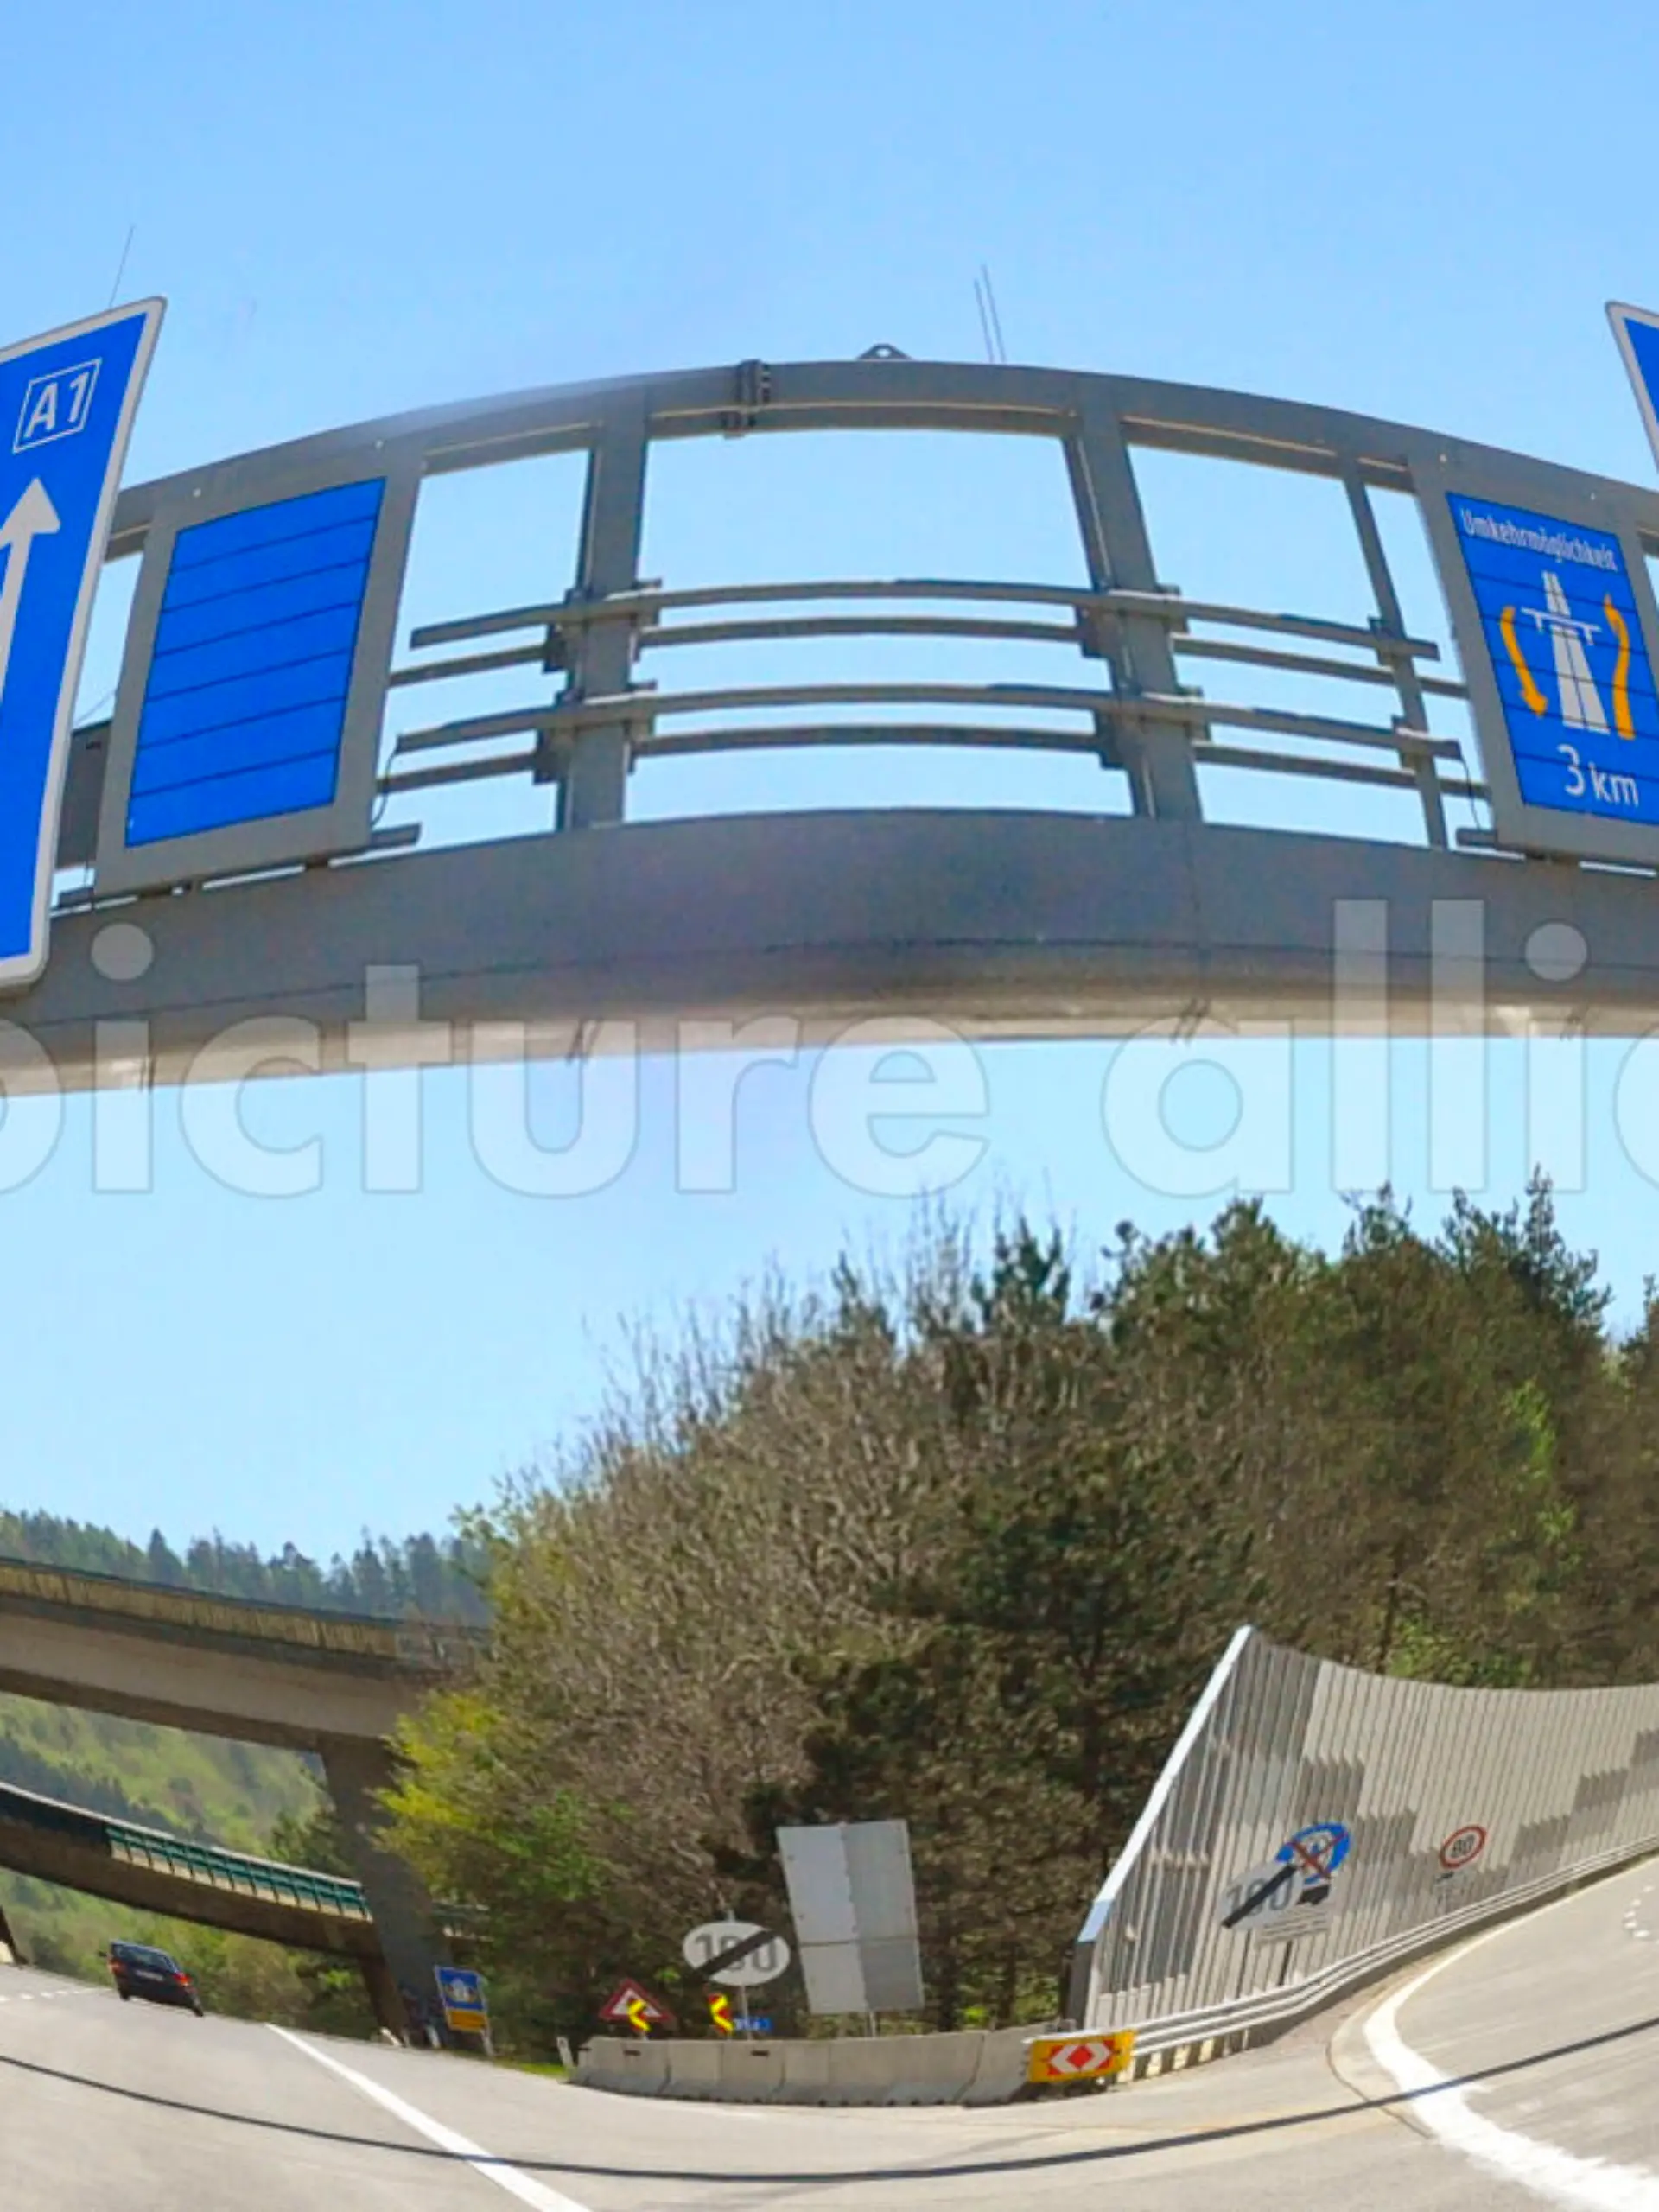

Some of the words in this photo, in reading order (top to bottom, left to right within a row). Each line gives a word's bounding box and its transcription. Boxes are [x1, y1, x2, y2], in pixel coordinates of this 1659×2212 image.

[24, 372, 89, 438] A1
[1460, 508, 1618, 572] Umkehrmöglichkeit
[1557, 743, 1585, 797] 3
[1588, 761, 1638, 807] km
